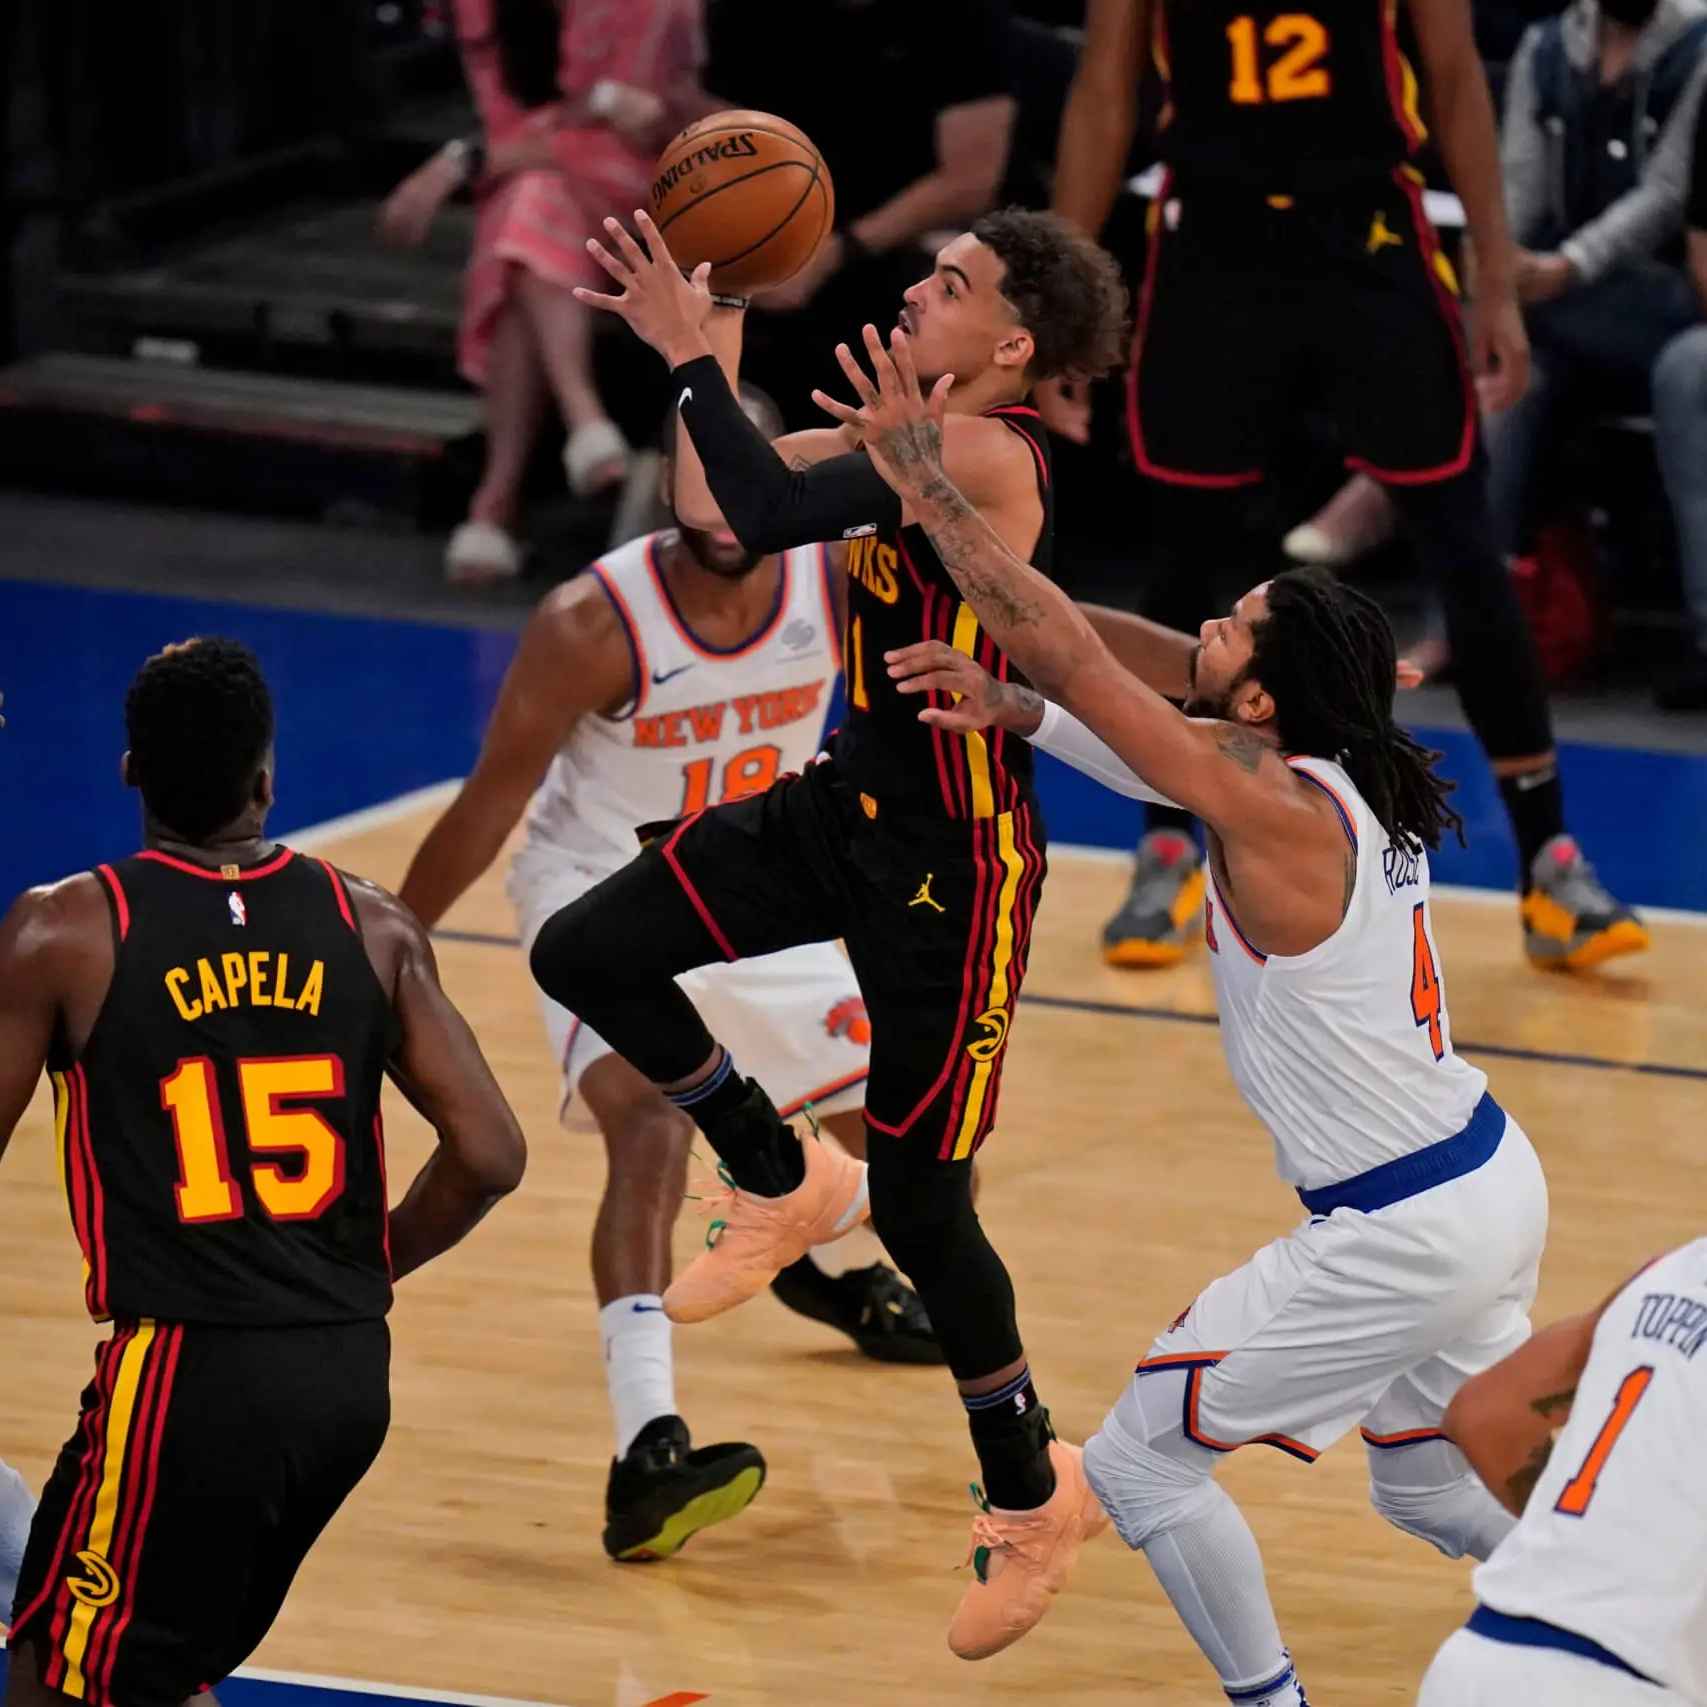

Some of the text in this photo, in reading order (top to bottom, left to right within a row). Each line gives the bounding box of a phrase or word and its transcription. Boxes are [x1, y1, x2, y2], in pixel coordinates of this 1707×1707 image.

[1225, 13, 1331, 104] 12
[652, 133, 758, 211] SPALDING
[631, 677, 828, 748] NEW YORK
[164, 951, 325, 1022] CAPELA
[1409, 901, 1445, 1063] 4
[159, 1052, 347, 1225] 15
[1553, 1364, 1655, 1518] 1
